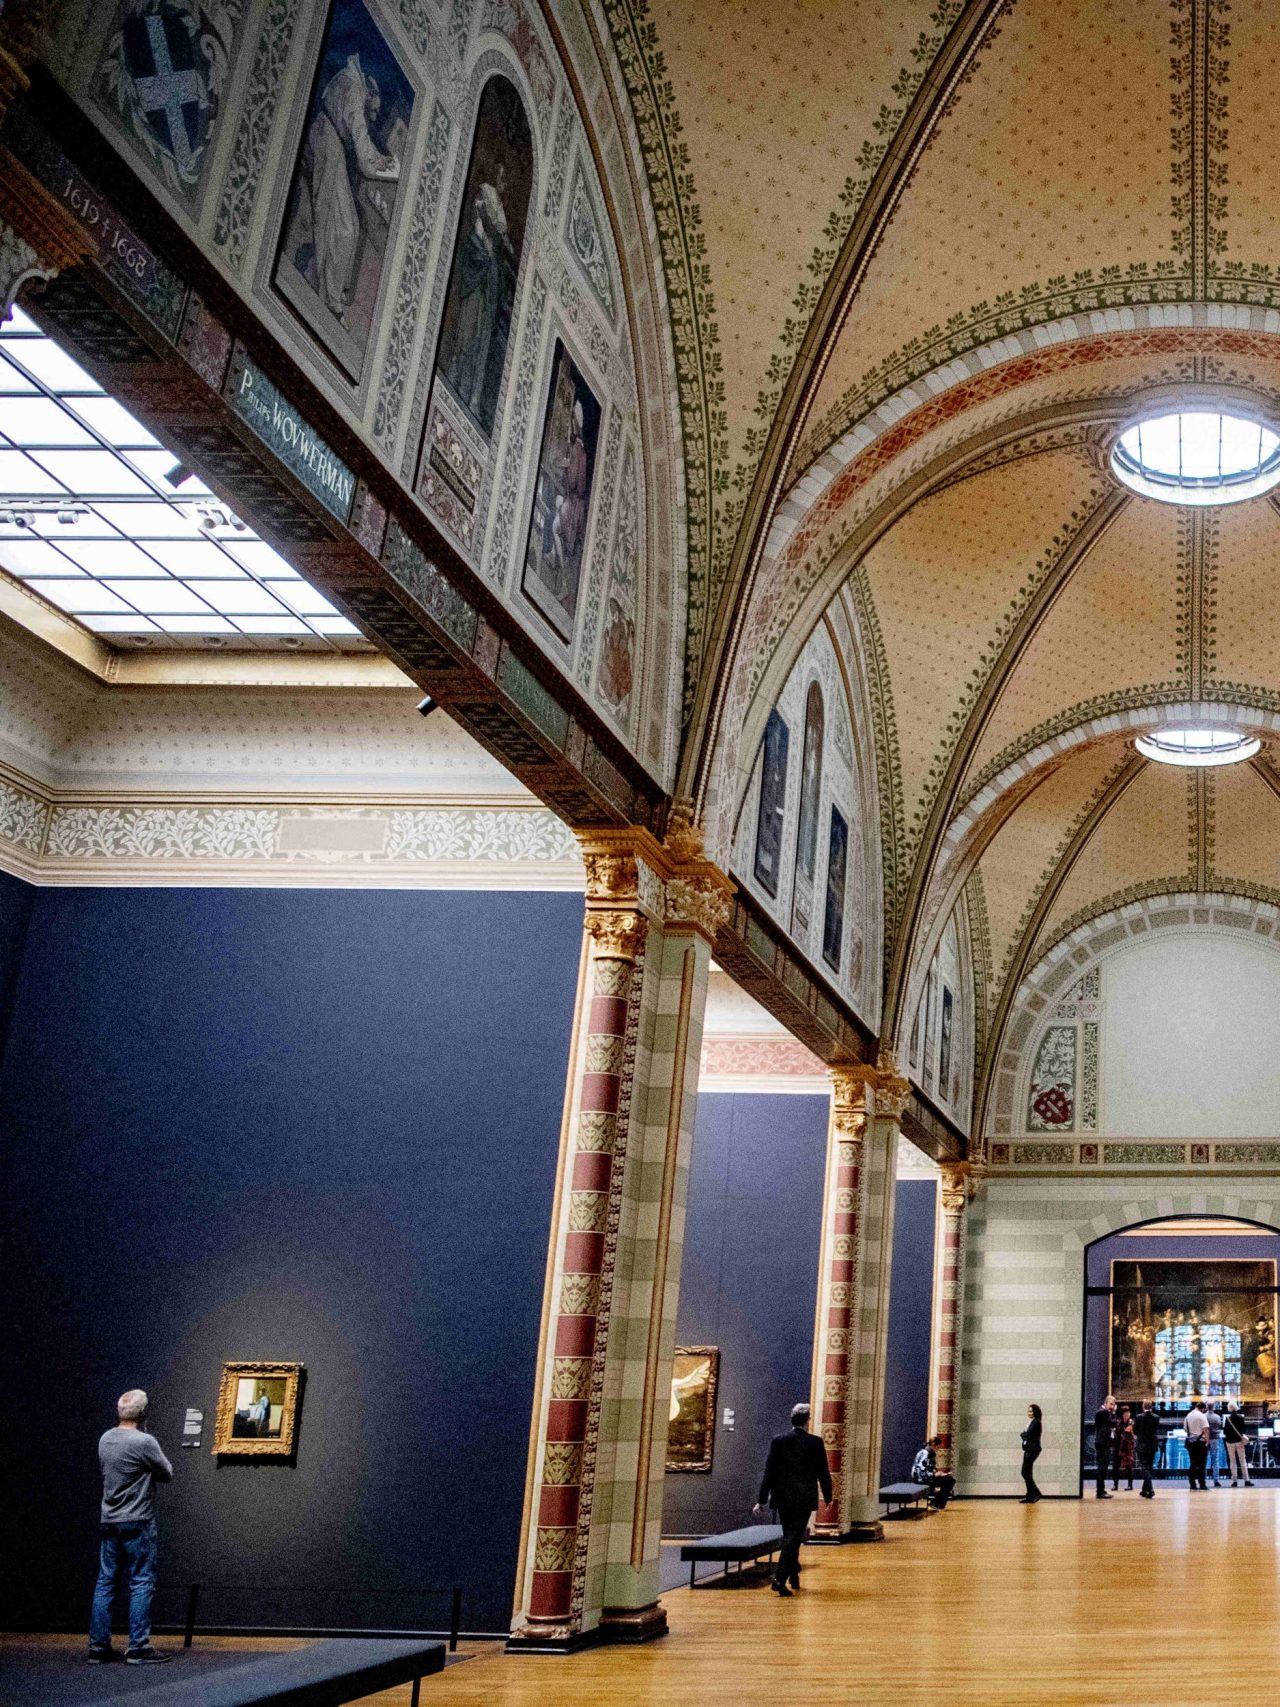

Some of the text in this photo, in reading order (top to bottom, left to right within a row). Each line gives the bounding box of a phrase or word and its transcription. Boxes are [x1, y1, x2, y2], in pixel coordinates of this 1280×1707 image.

[63, 178, 100, 224] 1619
[111, 230, 148, 278] 1668
[272, 402, 353, 506] WOVWERMAN
